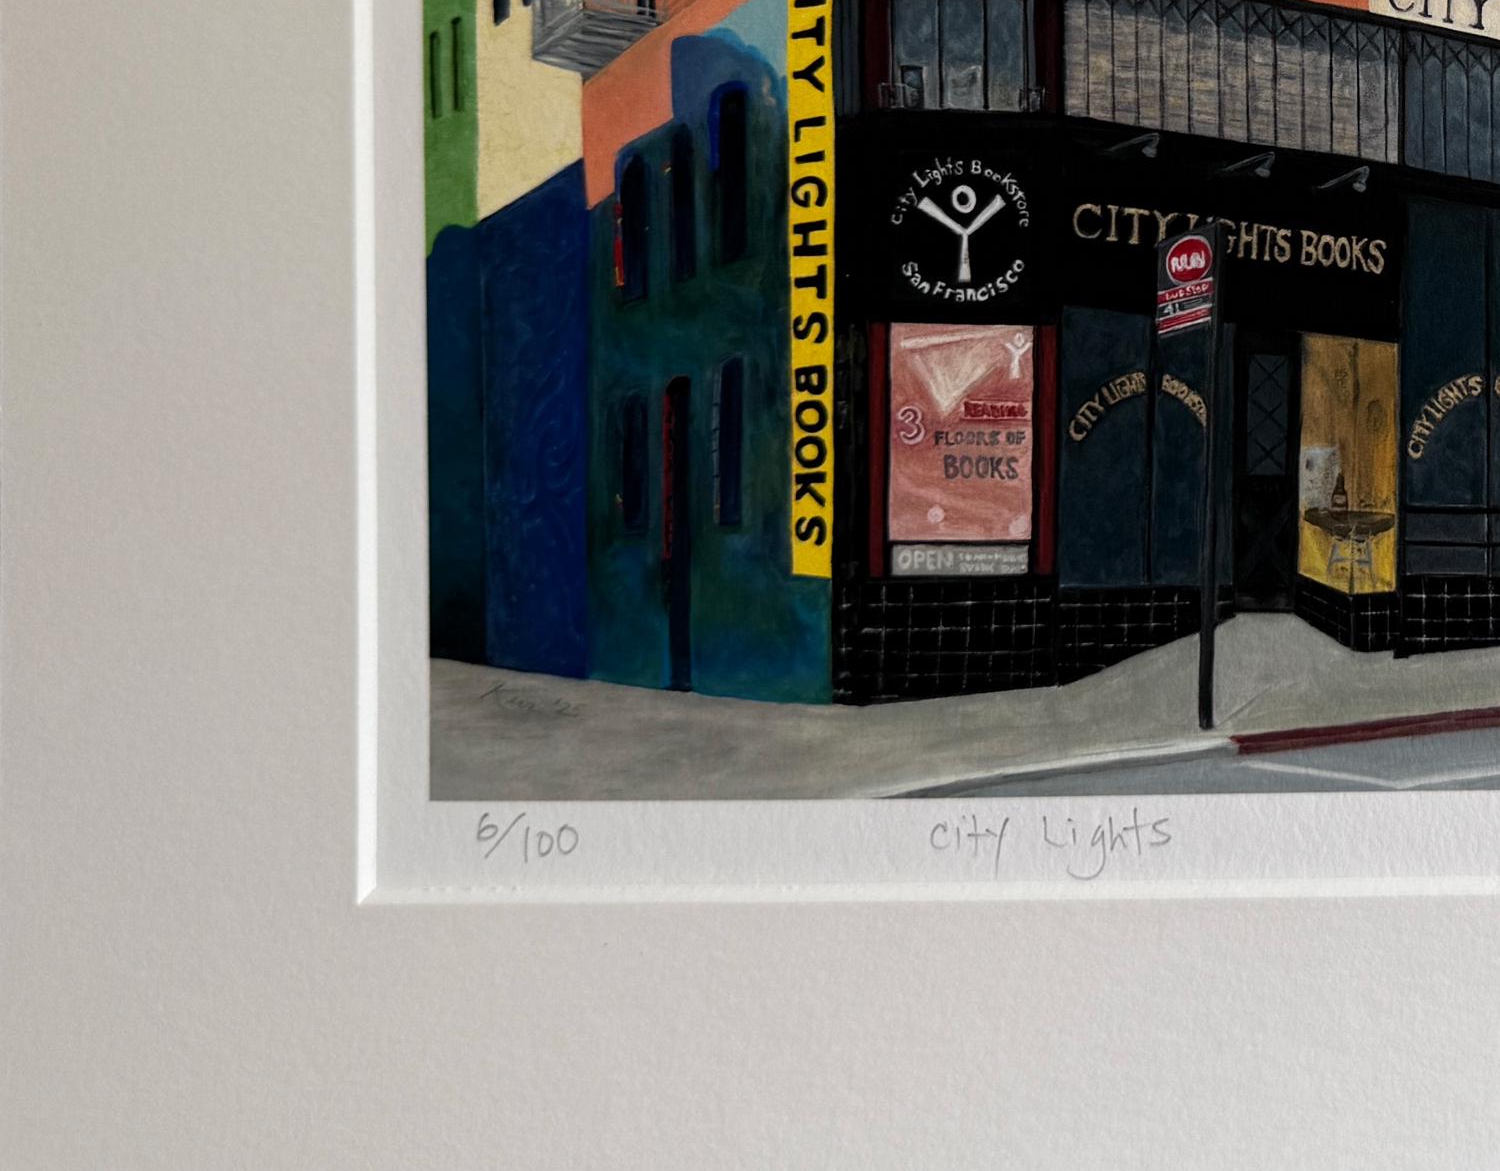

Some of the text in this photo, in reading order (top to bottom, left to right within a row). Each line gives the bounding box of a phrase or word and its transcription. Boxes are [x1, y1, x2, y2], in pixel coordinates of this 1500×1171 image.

[891, 156, 1030, 228] City Lights Bookstore
[791, 115, 829, 345] LIGHTS
[1072, 202, 1179, 245] CITY
[1300, 229, 1388, 275] BOOKS
[902, 258, 1026, 303] San Francisco
[897, 404, 926, 446] 3
[933, 430, 1026, 446] FLOORS OF
[1069, 391, 1105, 442] CITY
[1407, 413, 1435, 460] CITY
[1423, 375, 1485, 423] LIGHTS
[794, 364, 829, 547] BOOKS
[943, 453, 1020, 480] BOOKS
[898, 548, 955, 571] OPEN
[476, 811, 580, 864] 6/100
[1042, 806, 1172, 880] Lights
